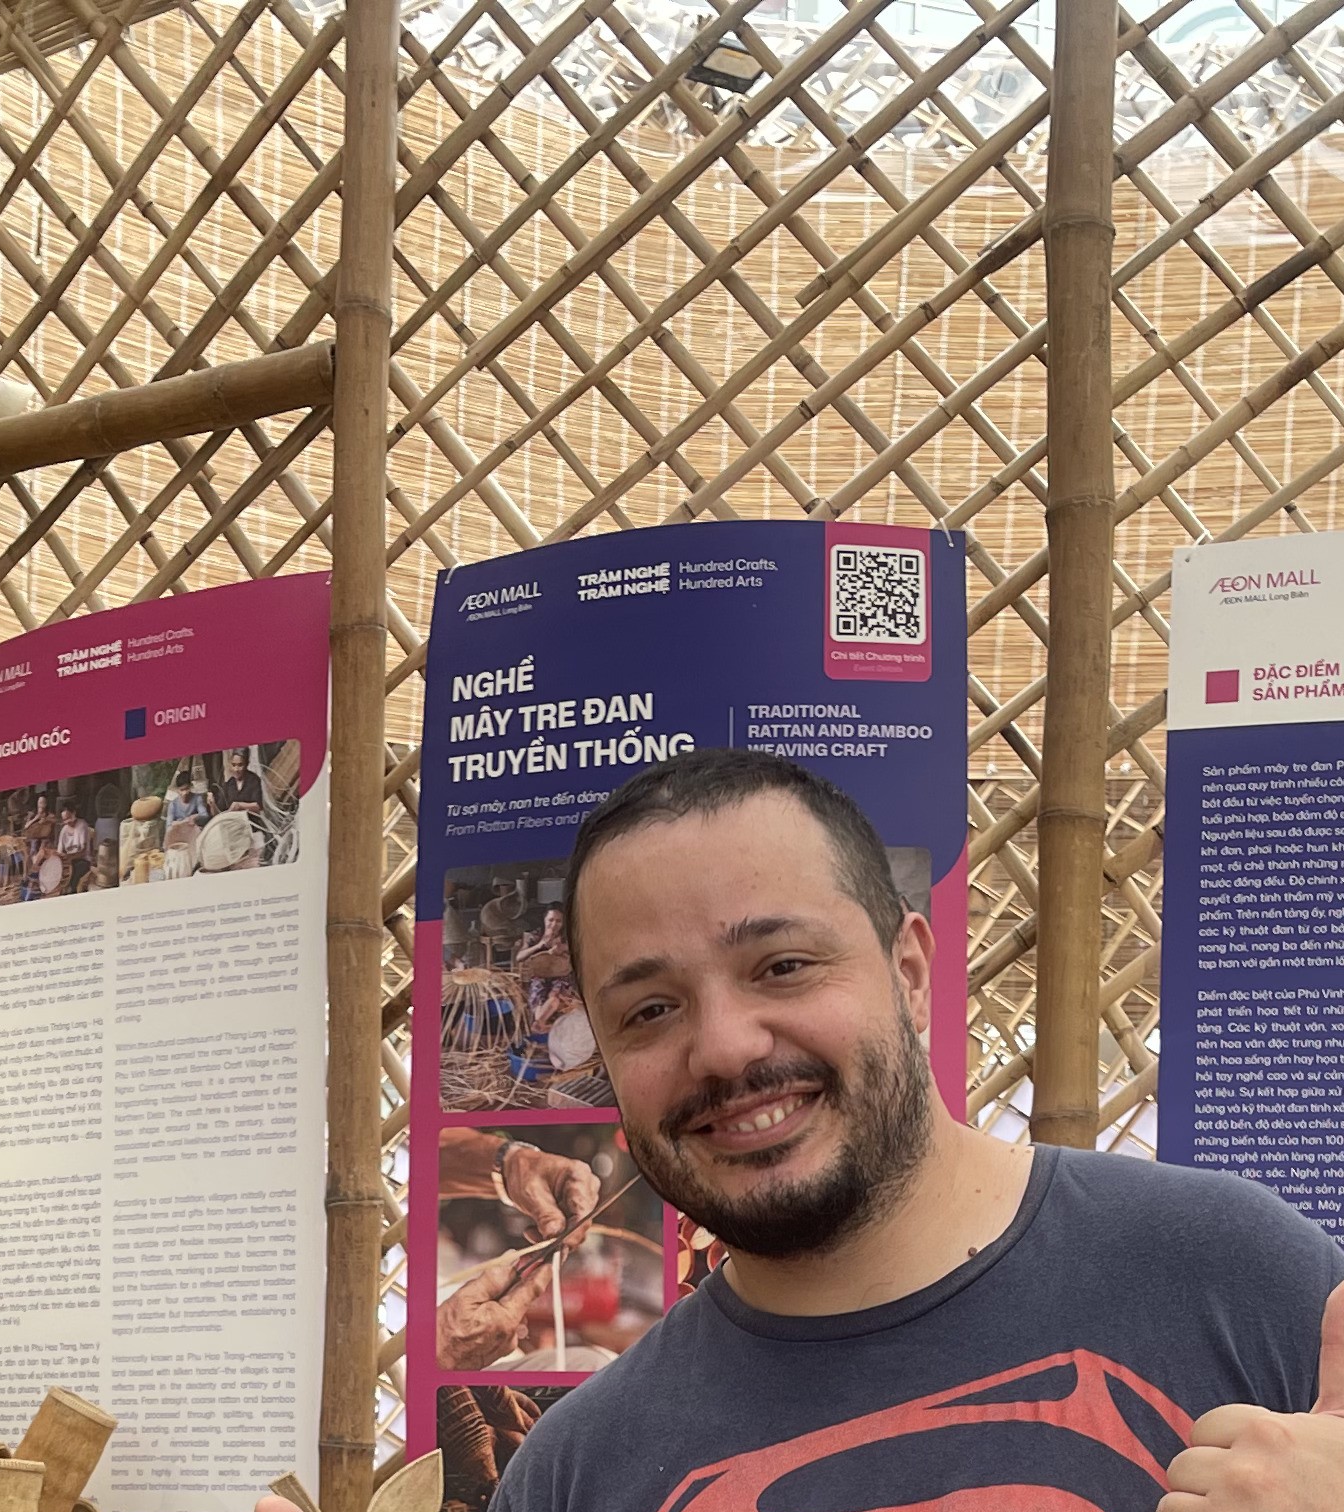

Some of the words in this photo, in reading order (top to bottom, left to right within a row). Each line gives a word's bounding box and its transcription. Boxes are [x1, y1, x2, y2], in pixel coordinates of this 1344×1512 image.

[680, 561, 733, 574] Hundred
[736, 558, 778, 571] Crafts,
[578, 569, 621, 587] TRĂM
[680, 577, 733, 590] Hundred
[735, 576, 762, 587] Arts
[1266, 569, 1321, 589] MALL
[501, 582, 542, 606] MALL
[578, 583, 621, 601] TRĂM
[1269, 593, 1289, 602] Long
[1290, 590, 1309, 600] Biên
[128, 632, 164, 648] Hundred
[58, 649, 88, 664] TRĂM
[127, 648, 164, 662] Hundred
[166, 643, 184, 655] Arts
[831, 651, 847, 660] Chi
[5, 662, 32, 680] MALL
[57, 663, 88, 677] TRĂM
[1296, 659, 1340, 678] ĐIỂM
[453, 655, 534, 702] NGHỀ
[1252, 681, 1289, 701] SẢN
[154, 703, 206, 727] ORIGIN
[450, 705, 513, 742] MÂY
[519, 701, 576, 732] TRE
[582, 693, 653, 725] ĐAN
[748, 705, 861, 718] TRADITIONAL
[40, 726, 70, 748] GỐC
[748, 724, 814, 738] RATTAN
[817, 725, 855, 738] AND
[858, 725, 932, 739] BAMBOO
[448, 736, 567, 782] TRUYỀN
[574, 726, 695, 768] THỐNG
[831, 743, 888, 757] CRAFT
[1293, 763, 1307, 772] tre
[1311, 761, 1332, 772] đan
[509, 799, 532, 810] nan
[534, 795, 549, 807] tre
[446, 823, 475, 836] From
[478, 820, 514, 834] Rattan
[517, 815, 553, 829] Fibers
[555, 812, 578, 825] and
[1326, 1135, 1344, 1145] 100
